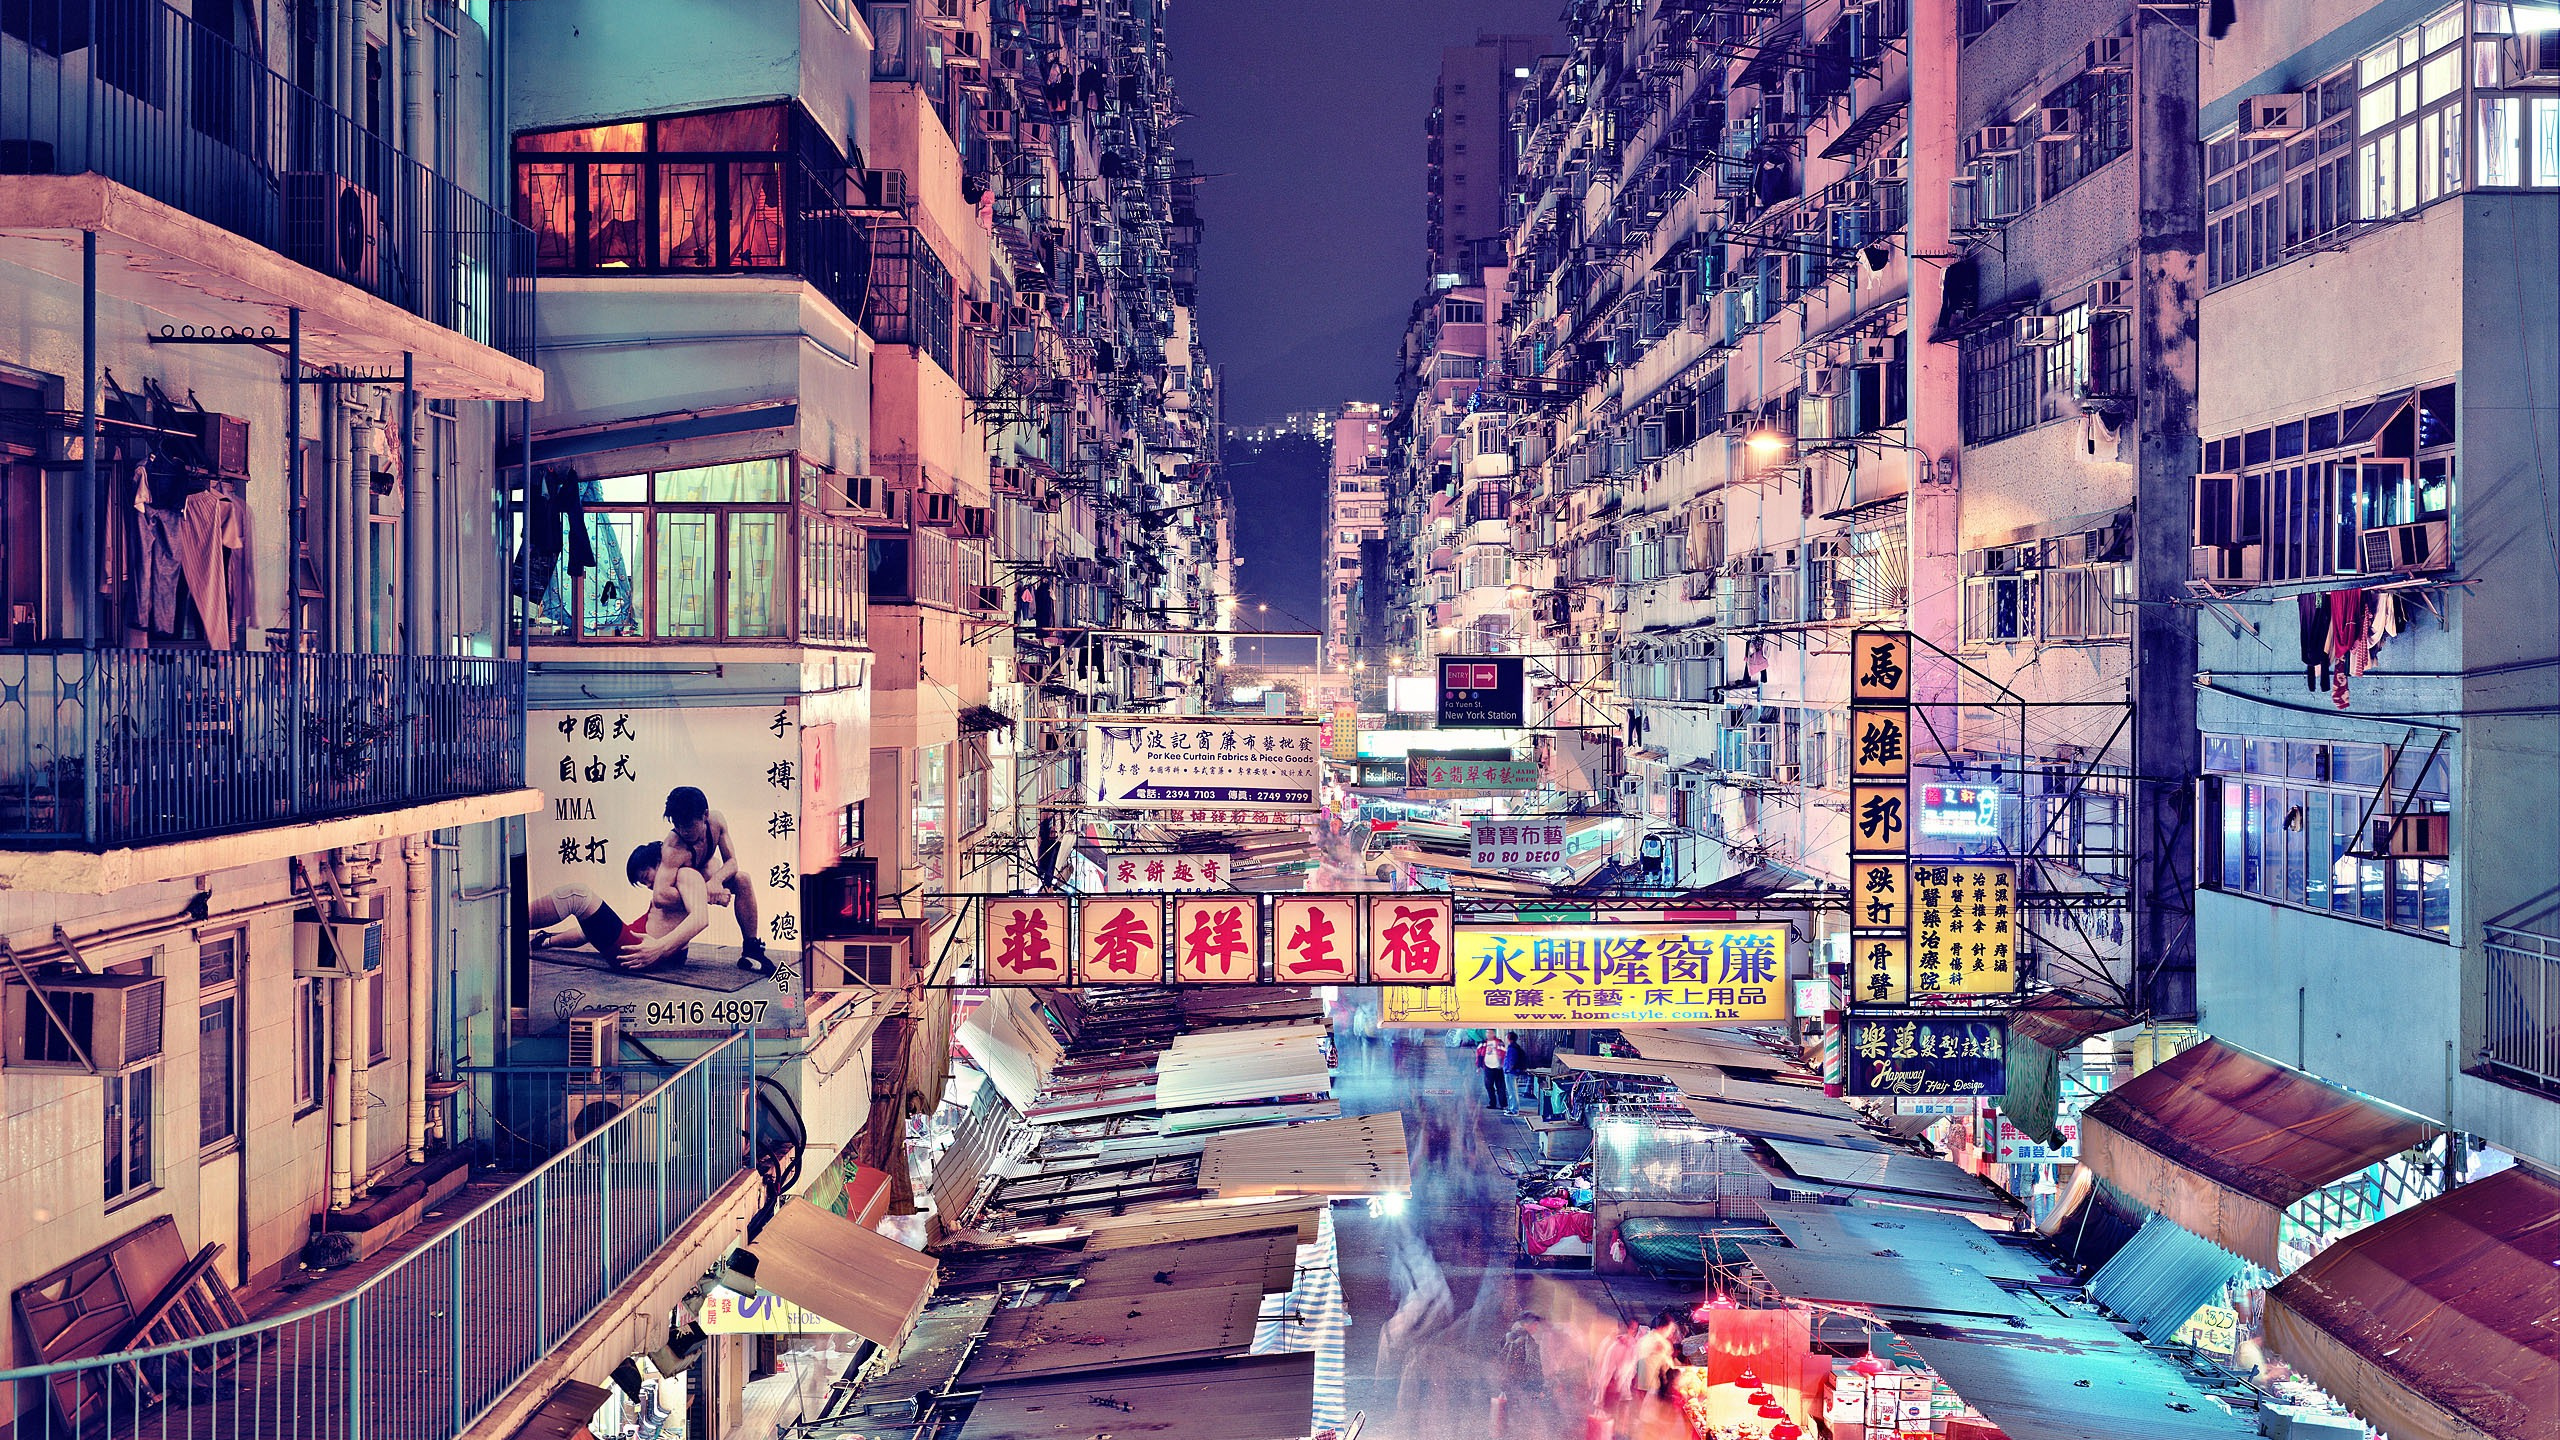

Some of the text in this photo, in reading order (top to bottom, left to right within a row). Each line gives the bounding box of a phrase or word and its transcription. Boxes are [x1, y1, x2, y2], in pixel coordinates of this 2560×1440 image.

[1445, 711, 1517, 720] New York Station
[557, 713, 637, 743] 中國式
[1147, 752, 1314, 764] Por Kee Curtain Fabrics & Piece Goods
[558, 754, 637, 784] 自由式
[1430, 765, 1515, 784] 金翡翠布藝
[1166, 789, 1190, 800] 2394
[1194, 789, 1215, 800] 7103
[1257, 791, 1281, 801] 2749
[1285, 792, 1309, 802] 9799
[555, 798, 597, 821] MMA
[1476, 825, 1563, 846] 寶寶布藝
[558, 836, 609, 865] 散打
[1477, 850, 1561, 863] BO BO DECO
[1468, 934, 1778, 986] 永興隆窗簾
[645, 1001, 705, 1026] 9416
[709, 999, 769, 1025] 4897
[1925, 1079, 1985, 1095] Hair Design
[786, 1312, 821, 1325] SHOES
